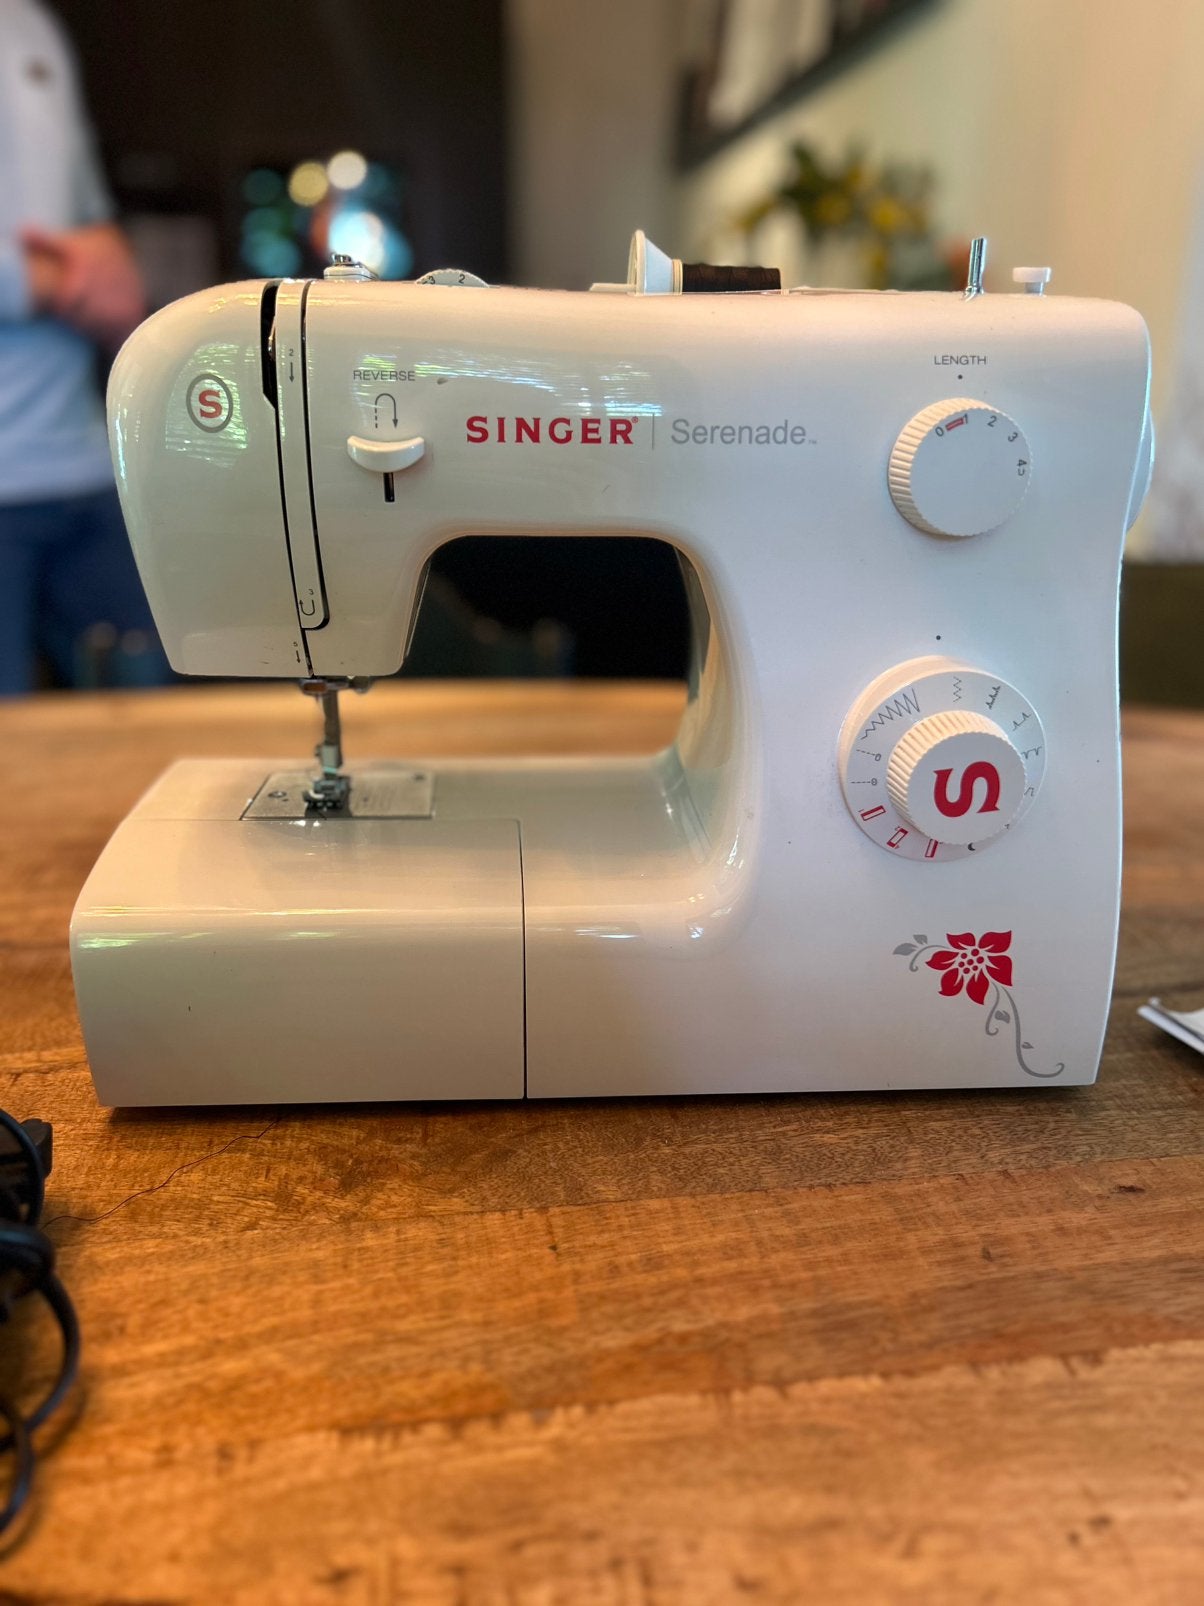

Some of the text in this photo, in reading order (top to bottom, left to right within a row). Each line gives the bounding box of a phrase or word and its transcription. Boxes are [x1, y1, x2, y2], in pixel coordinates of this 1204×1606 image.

[458, 274, 466, 284] 2
[288, 348, 294, 356] 2
[934, 355, 987, 365] LENGTH
[353, 369, 416, 381] REVERSE
[198, 389, 223, 419] S
[935, 426, 944, 437] 0
[987, 415, 998, 428] 2
[1007, 432, 1019, 442] 3
[933, 760, 1001, 818] S
